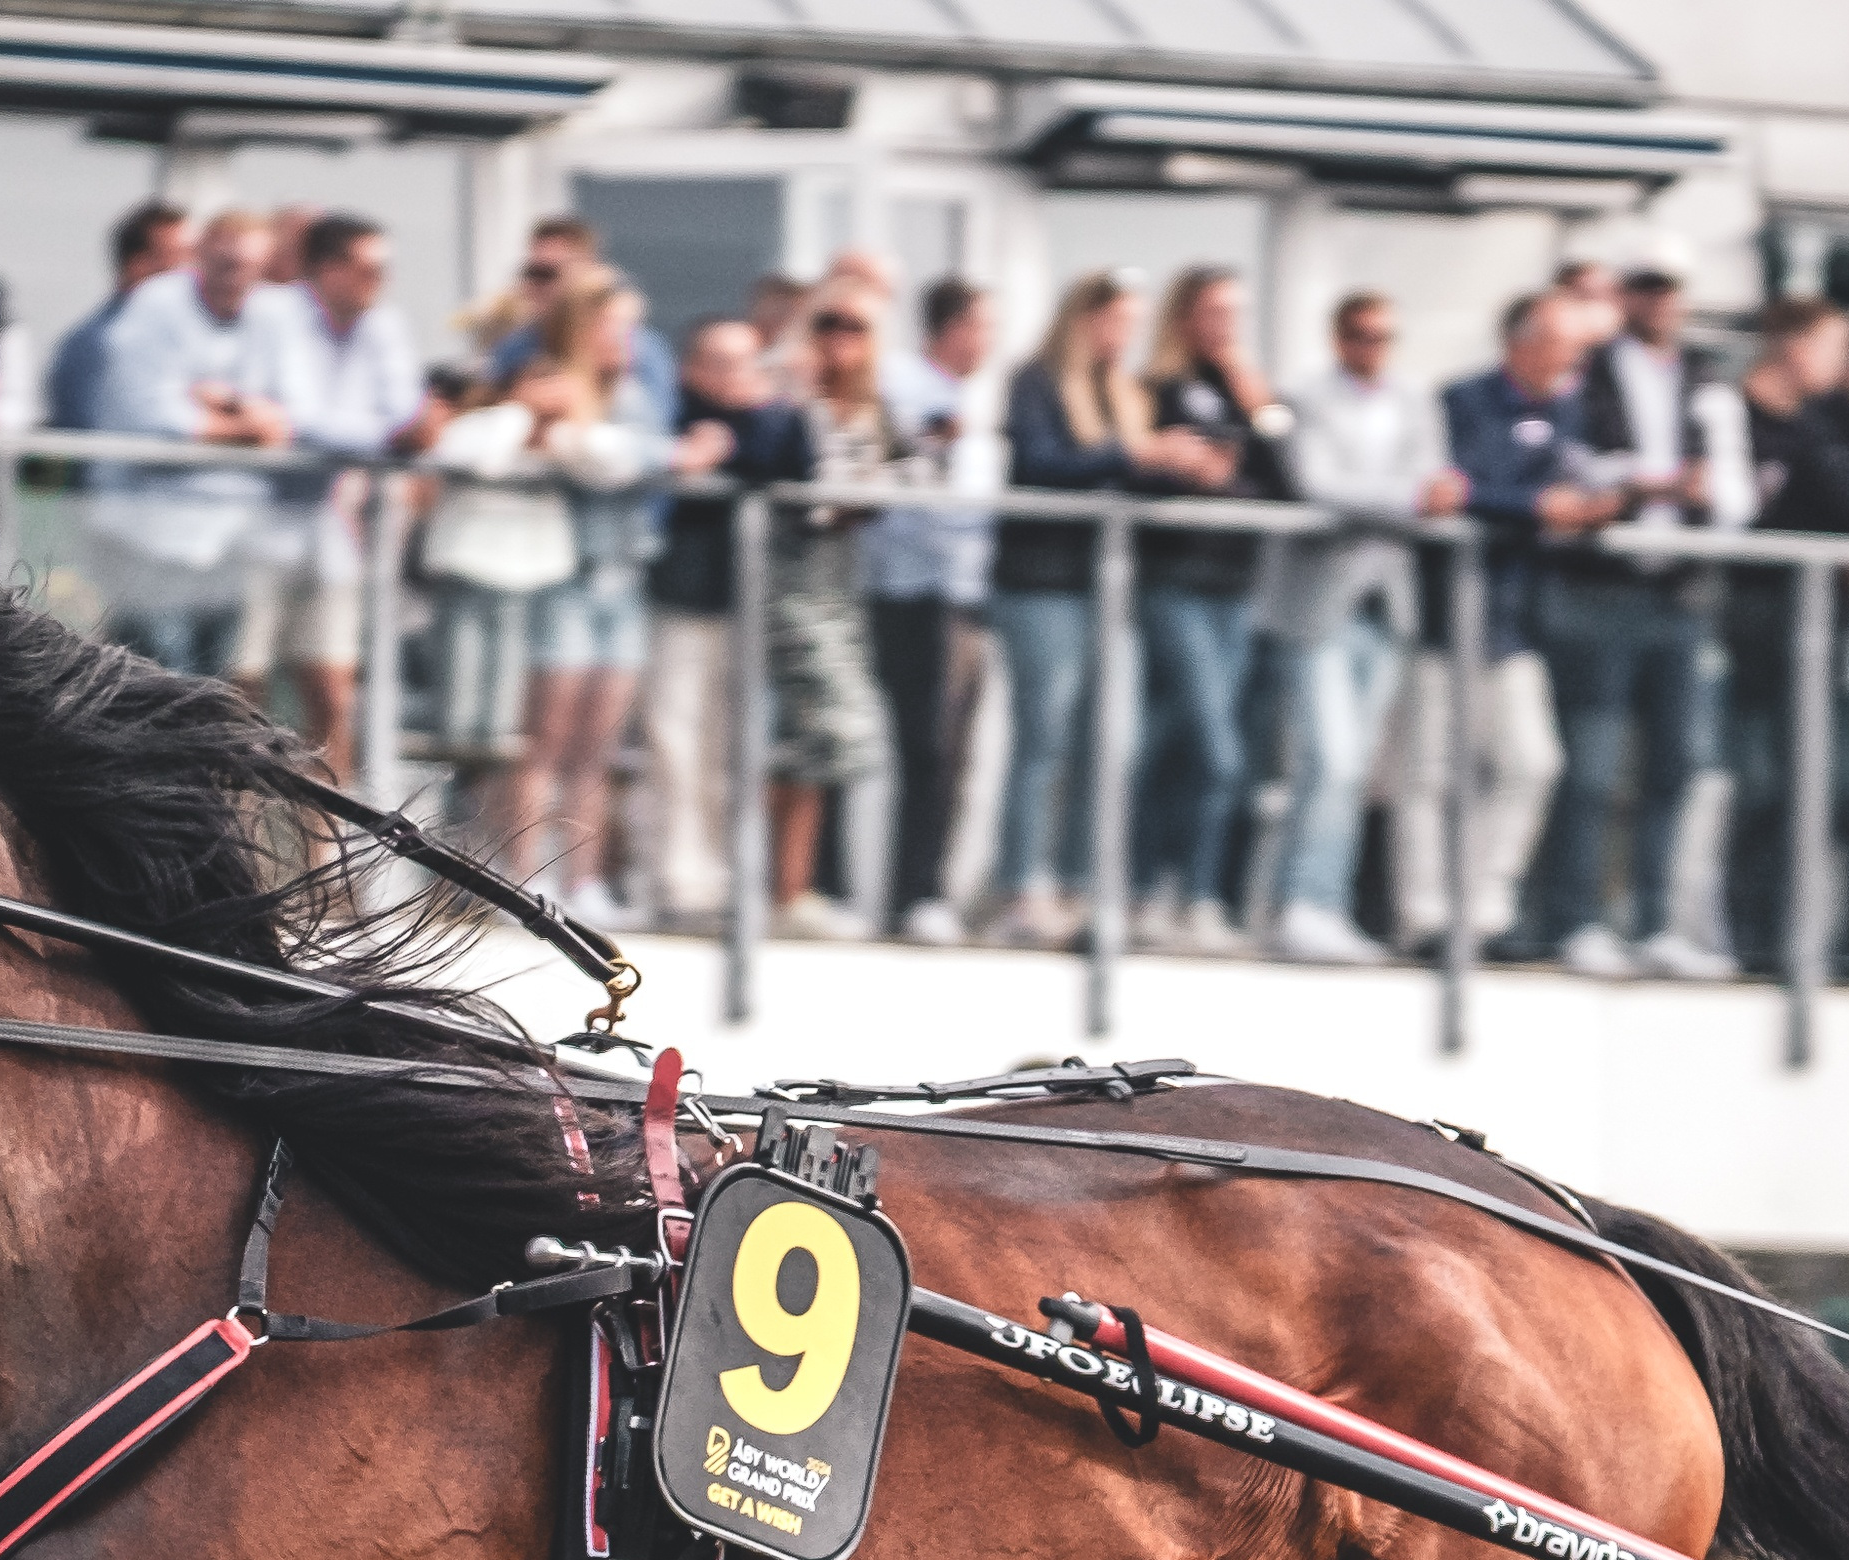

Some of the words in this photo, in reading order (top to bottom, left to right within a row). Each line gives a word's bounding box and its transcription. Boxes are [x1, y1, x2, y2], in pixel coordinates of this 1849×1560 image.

[718, 1201, 861, 1435] 9
[728, 1461, 782, 1497] GRAND
[782, 1477, 830, 1512] PRIX
[731, 1437, 764, 1466] ÅBY
[764, 1453, 821, 1489] WORLD
[707, 1482, 743, 1511] GET
[739, 1496, 755, 1518] A
[756, 1500, 803, 1536] WISH
